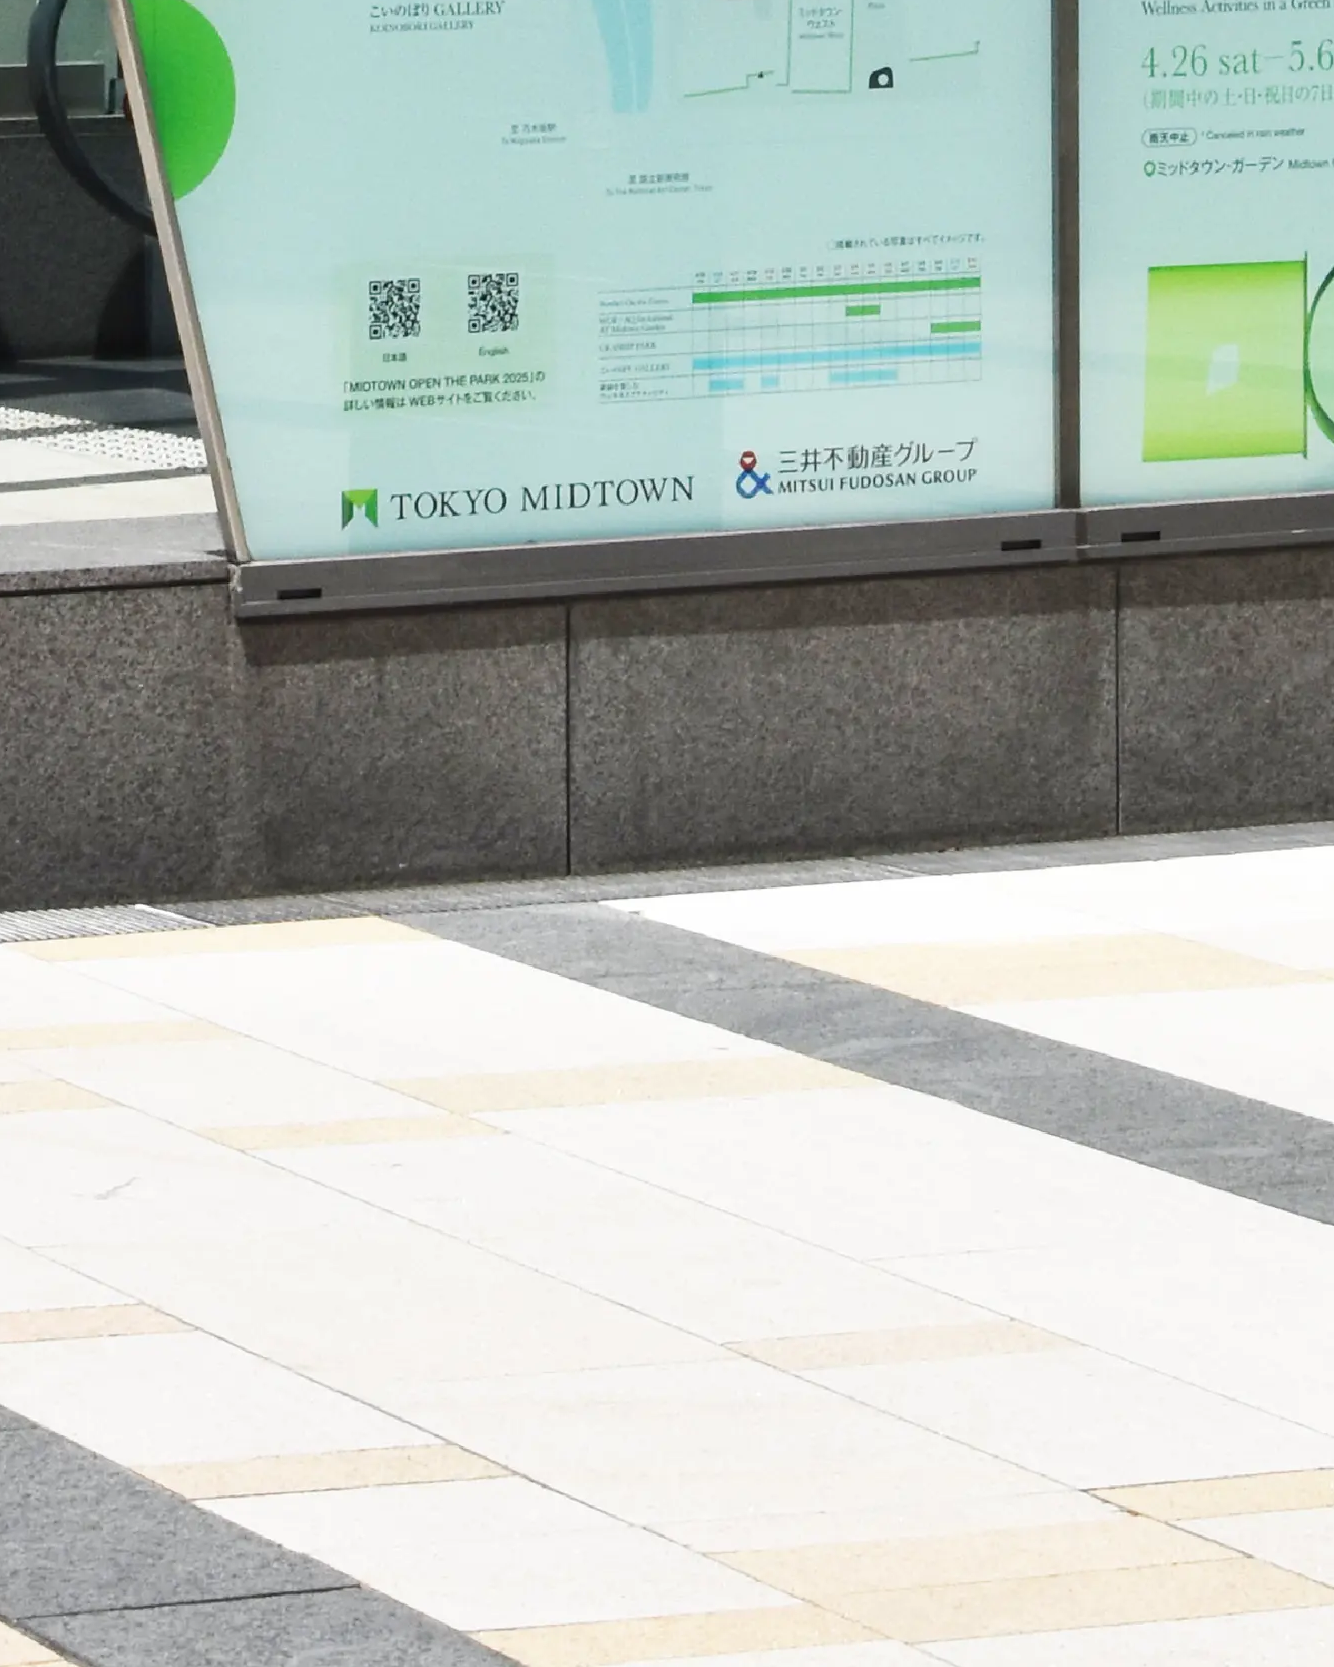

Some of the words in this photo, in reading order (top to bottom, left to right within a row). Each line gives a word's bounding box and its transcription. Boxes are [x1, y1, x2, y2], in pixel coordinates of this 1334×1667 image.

[434, 0, 505, 17] GALLERY
[1142, 0, 1196, 15] Wellness
[1141, 44, 1208, 78] 4.26
[479, 346, 510, 358] English
[409, 377, 441, 390] OPEN
[443, 375, 468, 388] THE
[470, 373, 500, 386] PARK
[778, 437, 978, 474] 三井不動産グループ
[778, 478, 834, 495] MITSUI
[839, 473, 917, 492] FUDOSAN
[921, 468, 978, 487] GROUP
[391, 487, 507, 521] TOKYO
[520, 474, 694, 514] MIDTOWN
